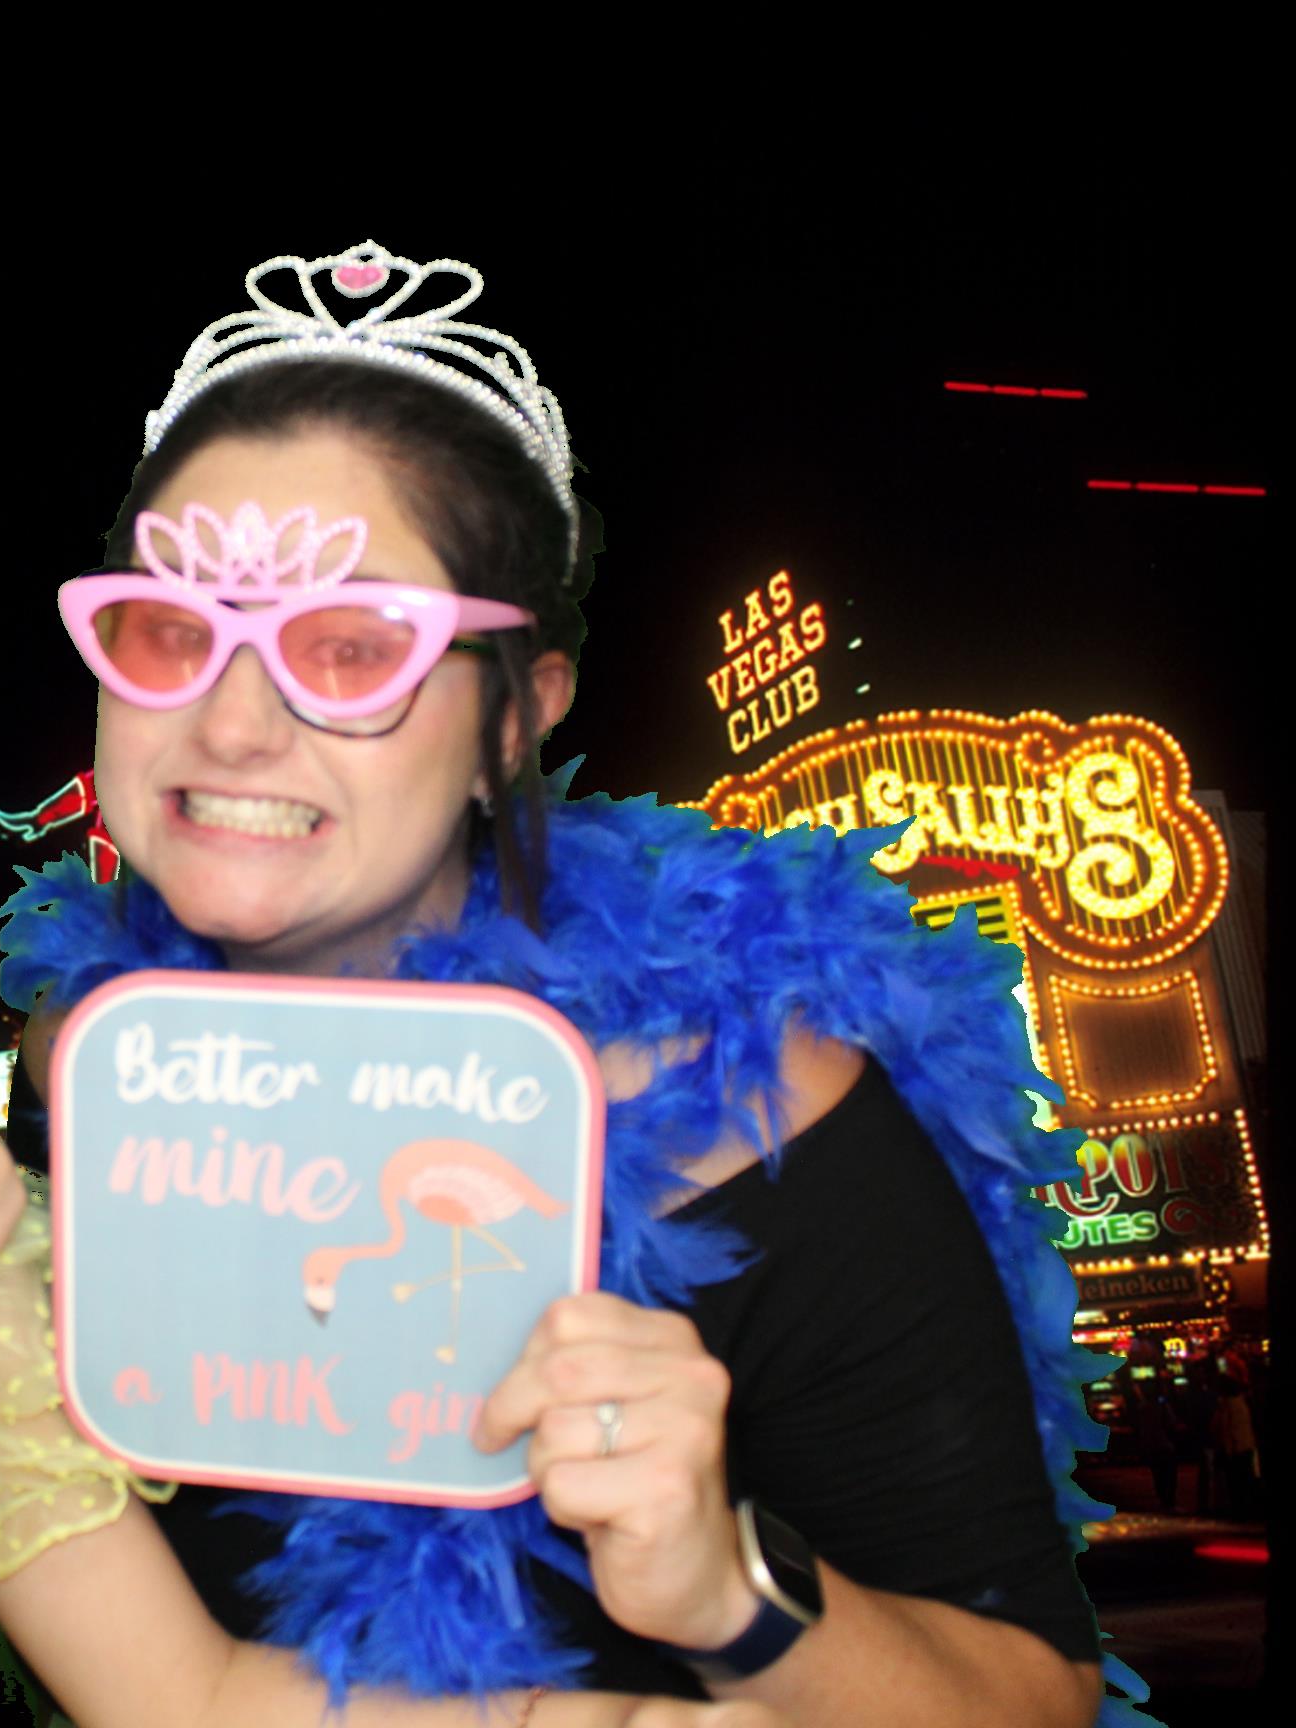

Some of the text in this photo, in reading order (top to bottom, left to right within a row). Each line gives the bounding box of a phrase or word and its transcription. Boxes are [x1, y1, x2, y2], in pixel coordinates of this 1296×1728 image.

[707, 602, 827, 711] VEGAS
[718, 570, 793, 654] LAS
[727, 664, 820, 755] CLUB
[114, 1021, 550, 1124] Better make
[108, 1126, 362, 1224] mine
[1077, 1273, 1192, 1302] eineken
[112, 1364, 164, 1408] a
